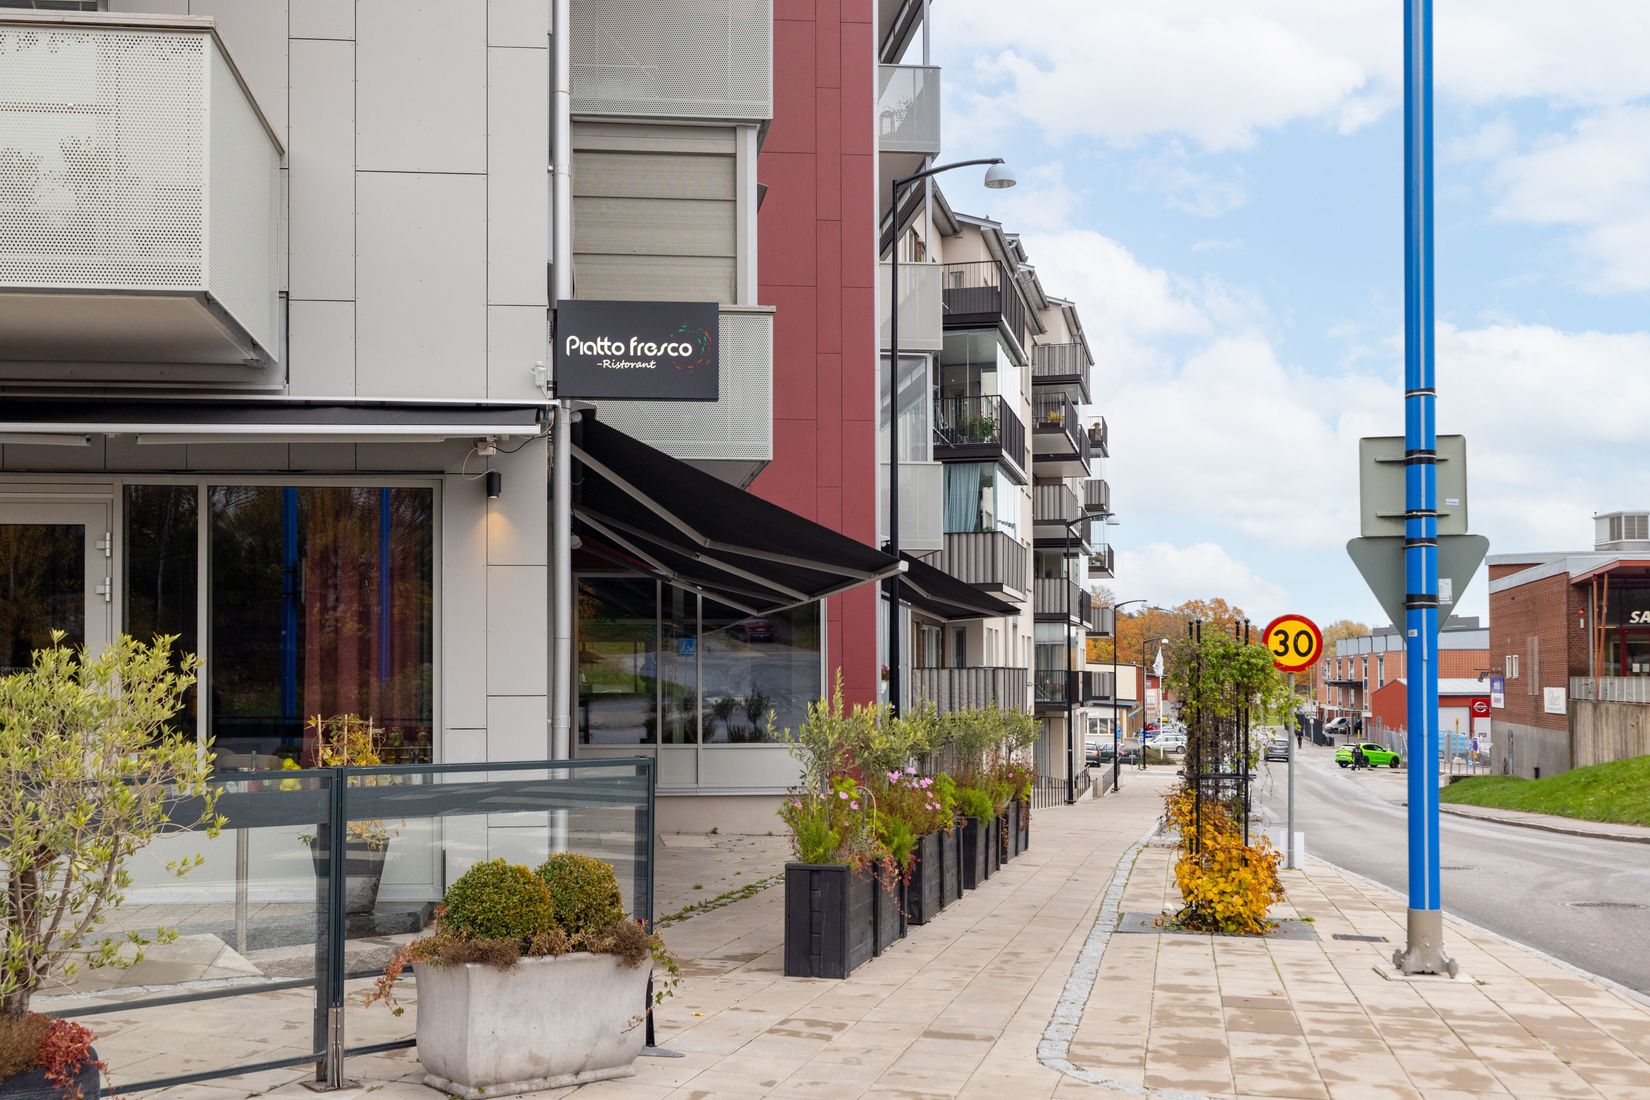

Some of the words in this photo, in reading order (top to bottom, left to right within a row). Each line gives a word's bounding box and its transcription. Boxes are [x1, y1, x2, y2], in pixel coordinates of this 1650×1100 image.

[566, 335, 625, 356] Piatto
[629, 336, 693, 357] fresco
[1273, 629, 1313, 657] 30
